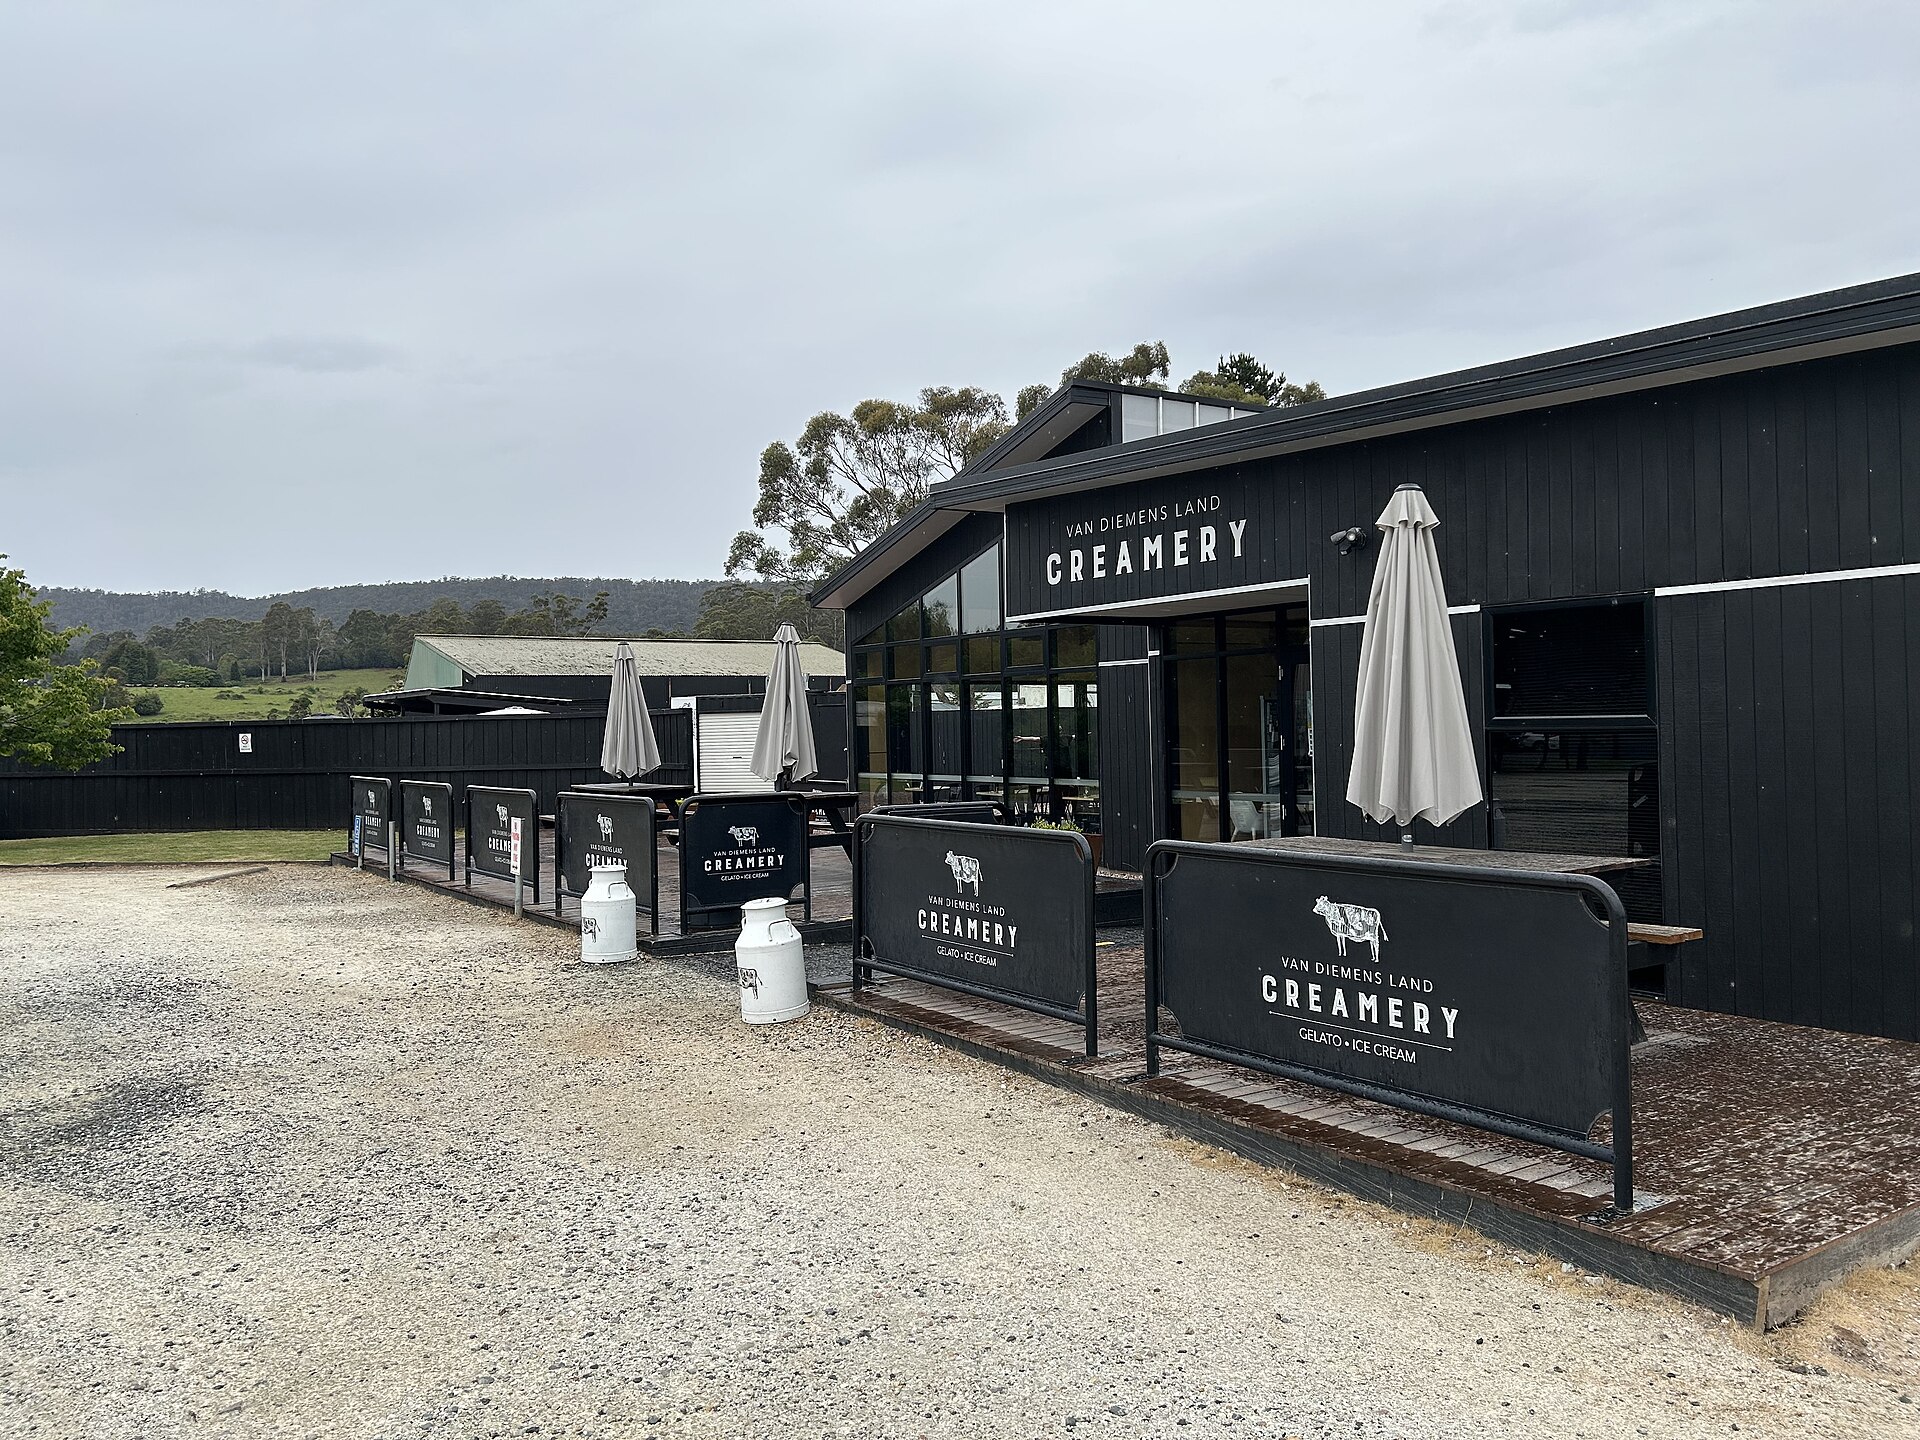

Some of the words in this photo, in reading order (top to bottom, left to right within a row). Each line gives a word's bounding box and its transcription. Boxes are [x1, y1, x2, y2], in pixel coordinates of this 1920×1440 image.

[1066, 521, 1093, 537] VAN
[1101, 506, 1167, 532] DIEMENS
[1176, 495, 1221, 517] LAND
[1047, 519, 1247, 585] CREAMERY
[365, 816, 381, 827] REAMERY
[489, 837, 511, 852] CREAME
[704, 855, 784, 871] CREAMERY
[928, 895, 943, 905] VAN
[946, 898, 980, 912] DIEMENS
[983, 905, 1005, 917] LAND
[918, 909, 1018, 948] CREAMERY
[937, 946, 959, 959] GELATO
[964, 952, 973, 962] ICE
[975, 954, 996, 967] CREAM
[1282, 956, 1309, 972] VAN
[1316, 962, 1382, 984] DIEMENS
[1390, 975, 1433, 993] LAND
[1262, 975, 1459, 1039] CREAMERY
[1299, 1028, 1342, 1046] GELATO
[1352, 1040, 1370, 1053] ICE
[1374, 1045, 1416, 1063] CREAM
